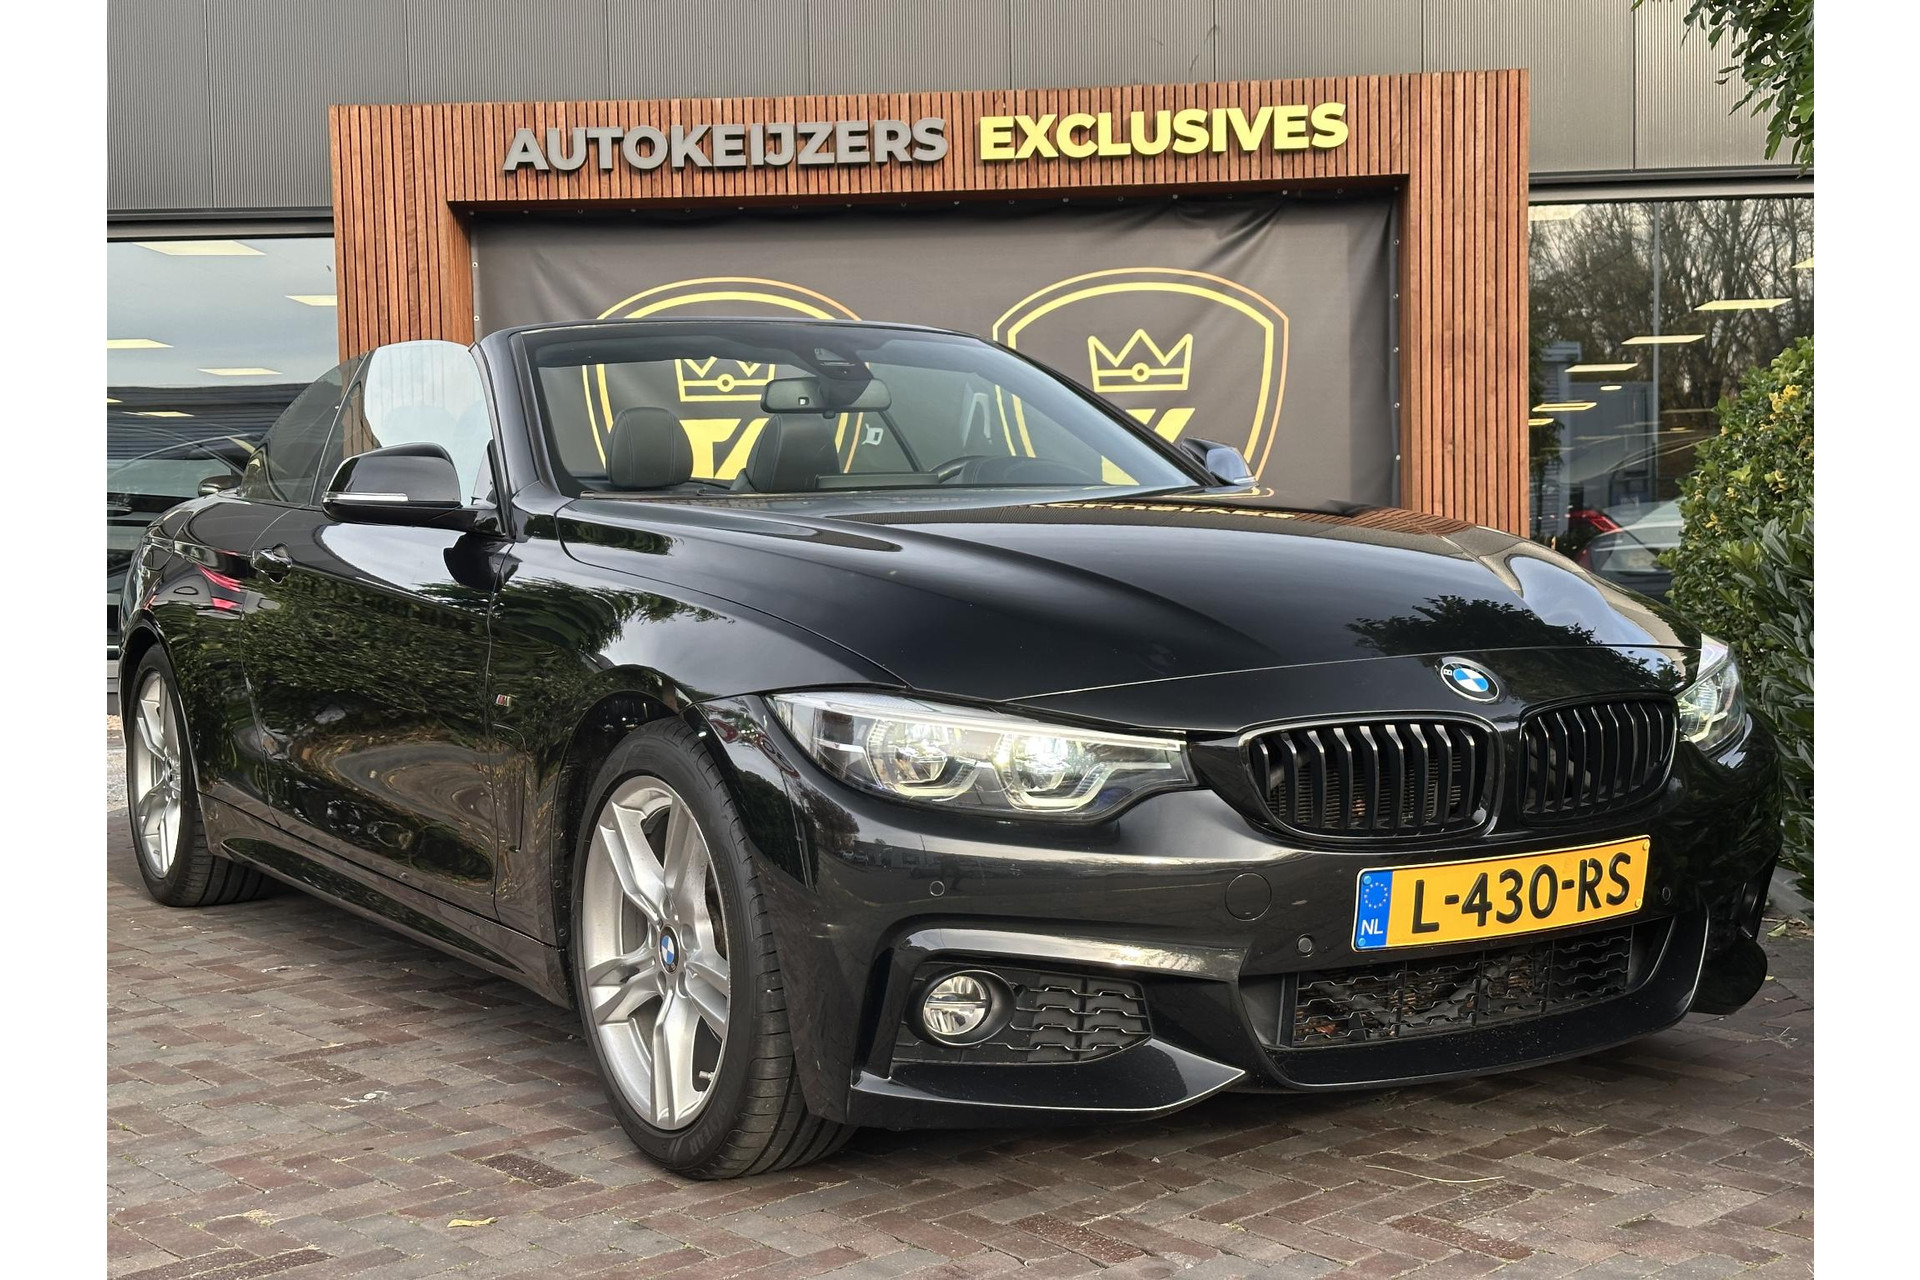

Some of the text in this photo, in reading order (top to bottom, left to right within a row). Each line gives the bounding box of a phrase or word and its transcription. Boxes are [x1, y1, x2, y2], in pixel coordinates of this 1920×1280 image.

[503, 101, 1350, 172] AUTOKEIJZERS EXCLUSIVES
[1360, 918, 1384, 936] NL
[1411, 852, 1632, 934] L-430-RS
